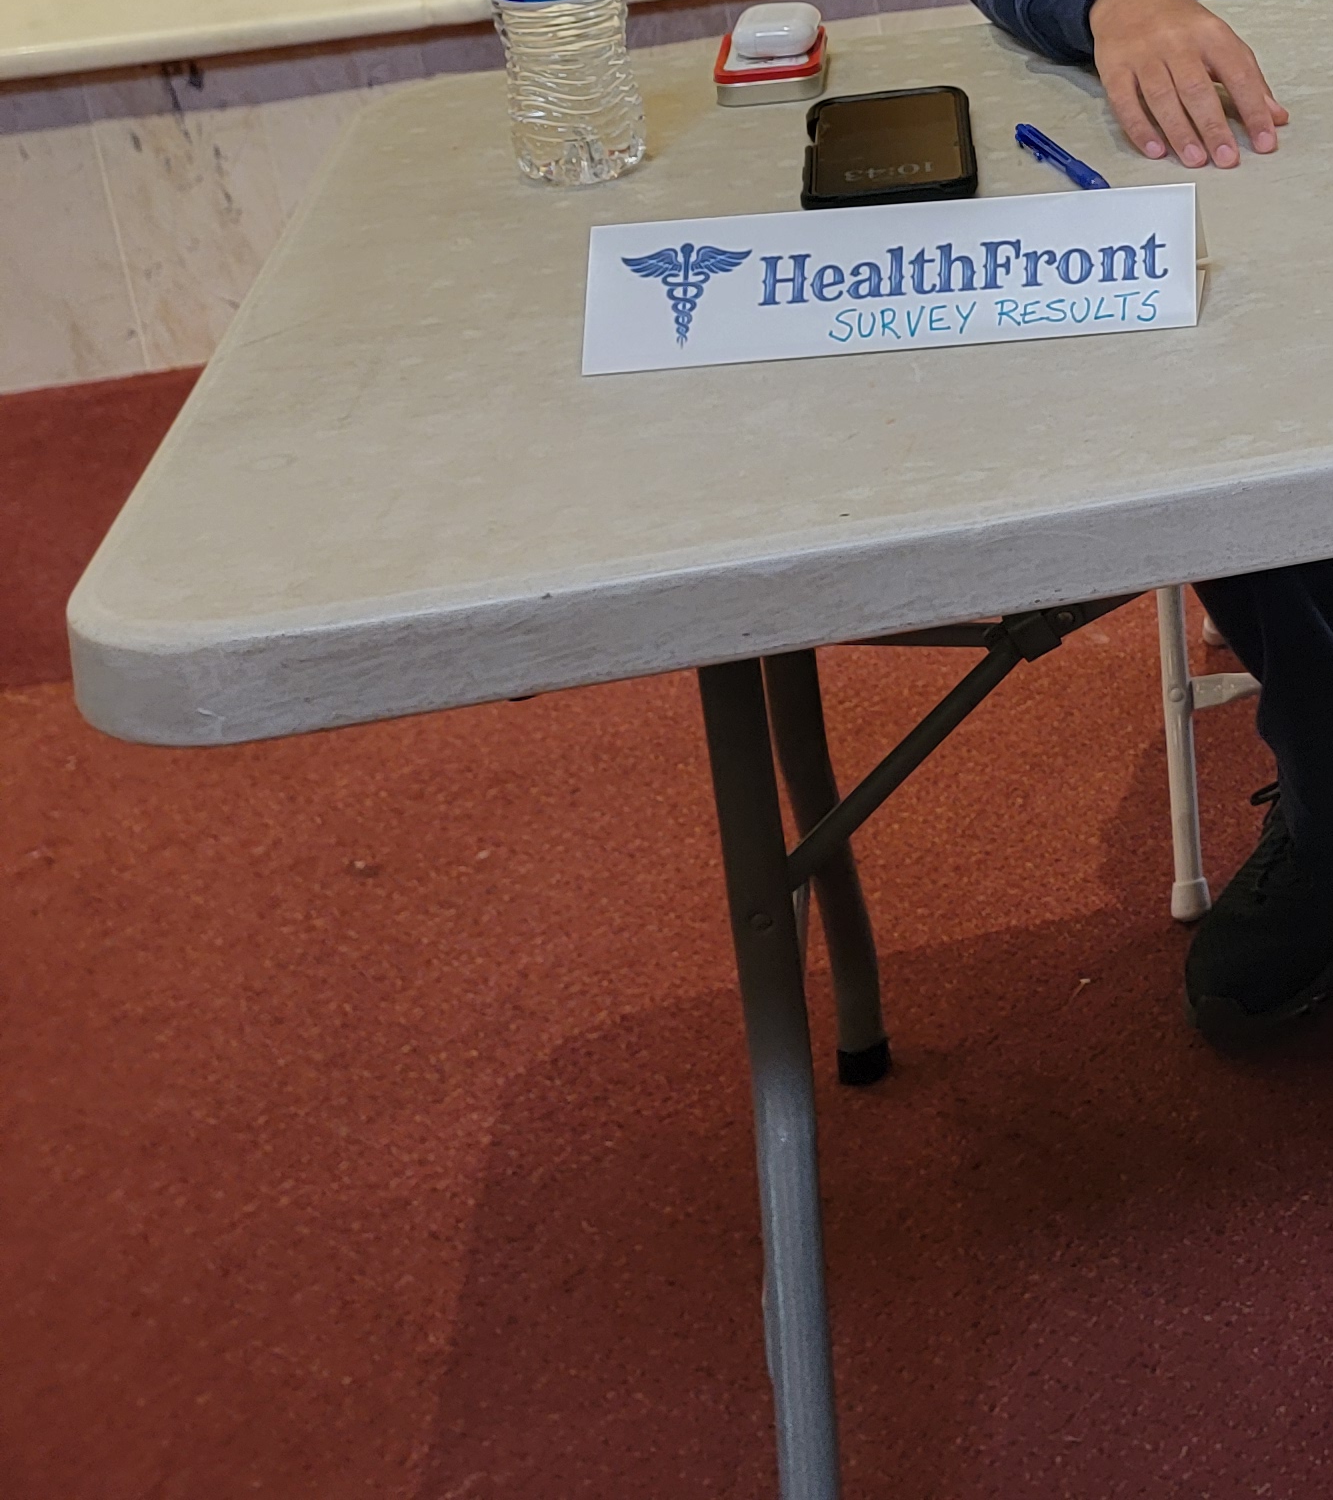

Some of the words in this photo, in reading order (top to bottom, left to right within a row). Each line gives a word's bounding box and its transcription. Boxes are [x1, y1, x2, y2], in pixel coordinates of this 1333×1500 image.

[843, 161, 934, 183] 10:43
[758, 233, 1169, 307] HealthFront
[829, 301, 977, 342] SURVEY
[997, 290, 1161, 327] RESULTS
